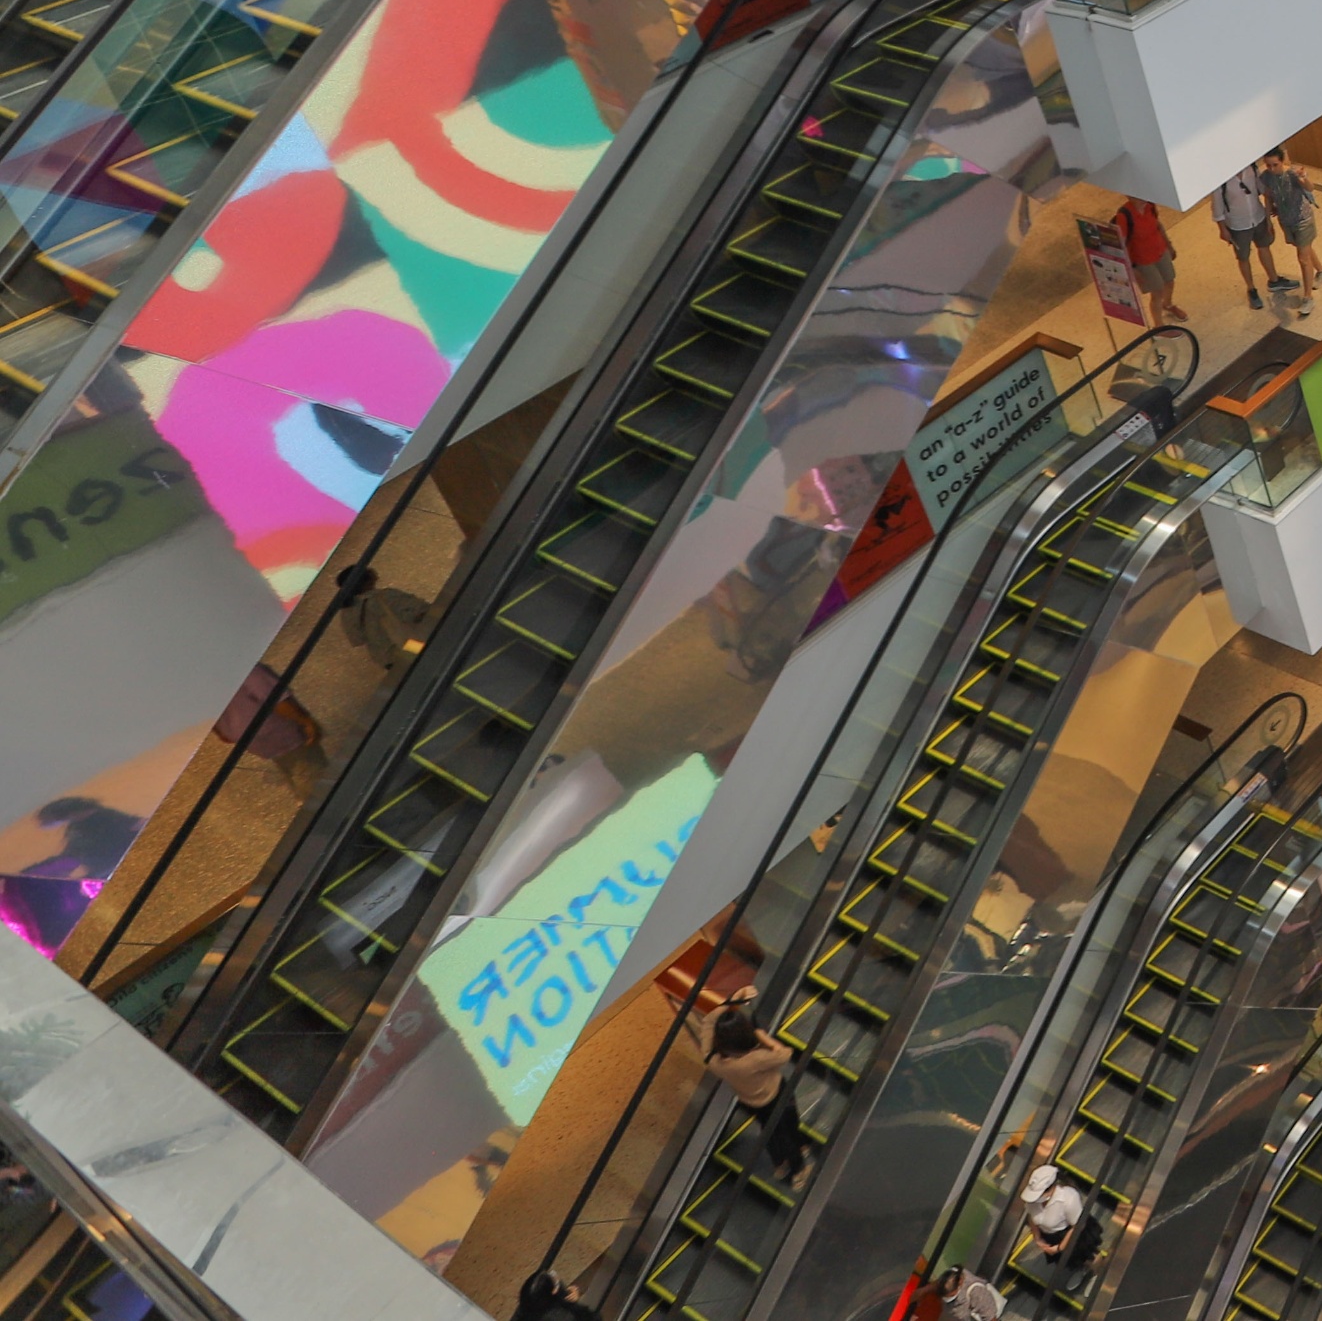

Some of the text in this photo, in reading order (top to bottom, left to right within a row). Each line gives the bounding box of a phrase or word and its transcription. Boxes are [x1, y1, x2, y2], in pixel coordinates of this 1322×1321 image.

[992, 364, 1041, 416] guide
[969, 385, 1048, 459] world of
